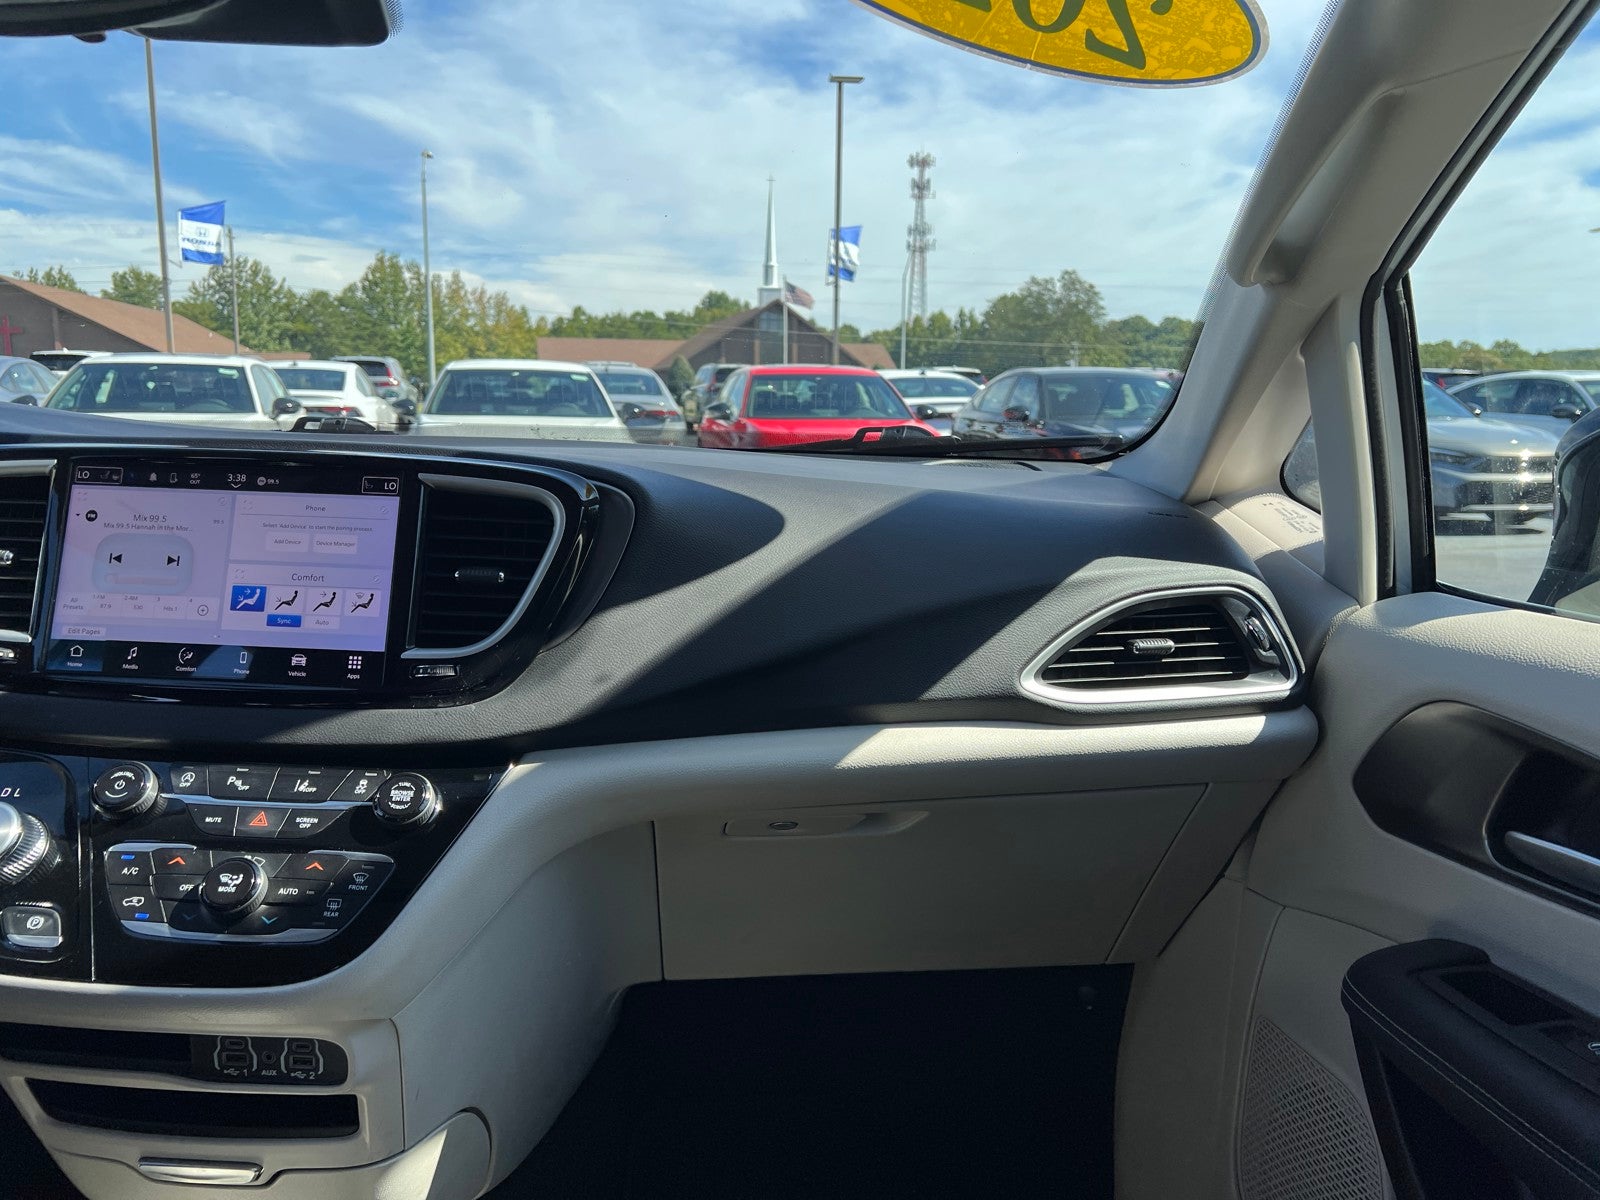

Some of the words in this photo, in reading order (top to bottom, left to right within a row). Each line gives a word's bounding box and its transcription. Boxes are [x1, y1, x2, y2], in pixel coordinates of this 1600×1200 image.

[77, 471, 90, 479] LO
[227, 473, 247, 482] 3:38
[384, 482, 396, 490] LO
[305, 504, 326, 512] Phone
[149, 514, 167, 522] 99.5
[291, 573, 325, 582] Comfort
[62, 603, 84, 611] Presets
[276, 617, 291, 625] Sync
[81, 628, 101, 636] Pages
[175, 665, 197, 673] Comfort
[1, 788, 12, 797] D
[13, 788, 21, 798] L
[121, 867, 139, 875] A/C
[278, 887, 299, 895] AUTO
[243, 1069, 249, 1077] 1
[309, 1071, 316, 1080] 2
